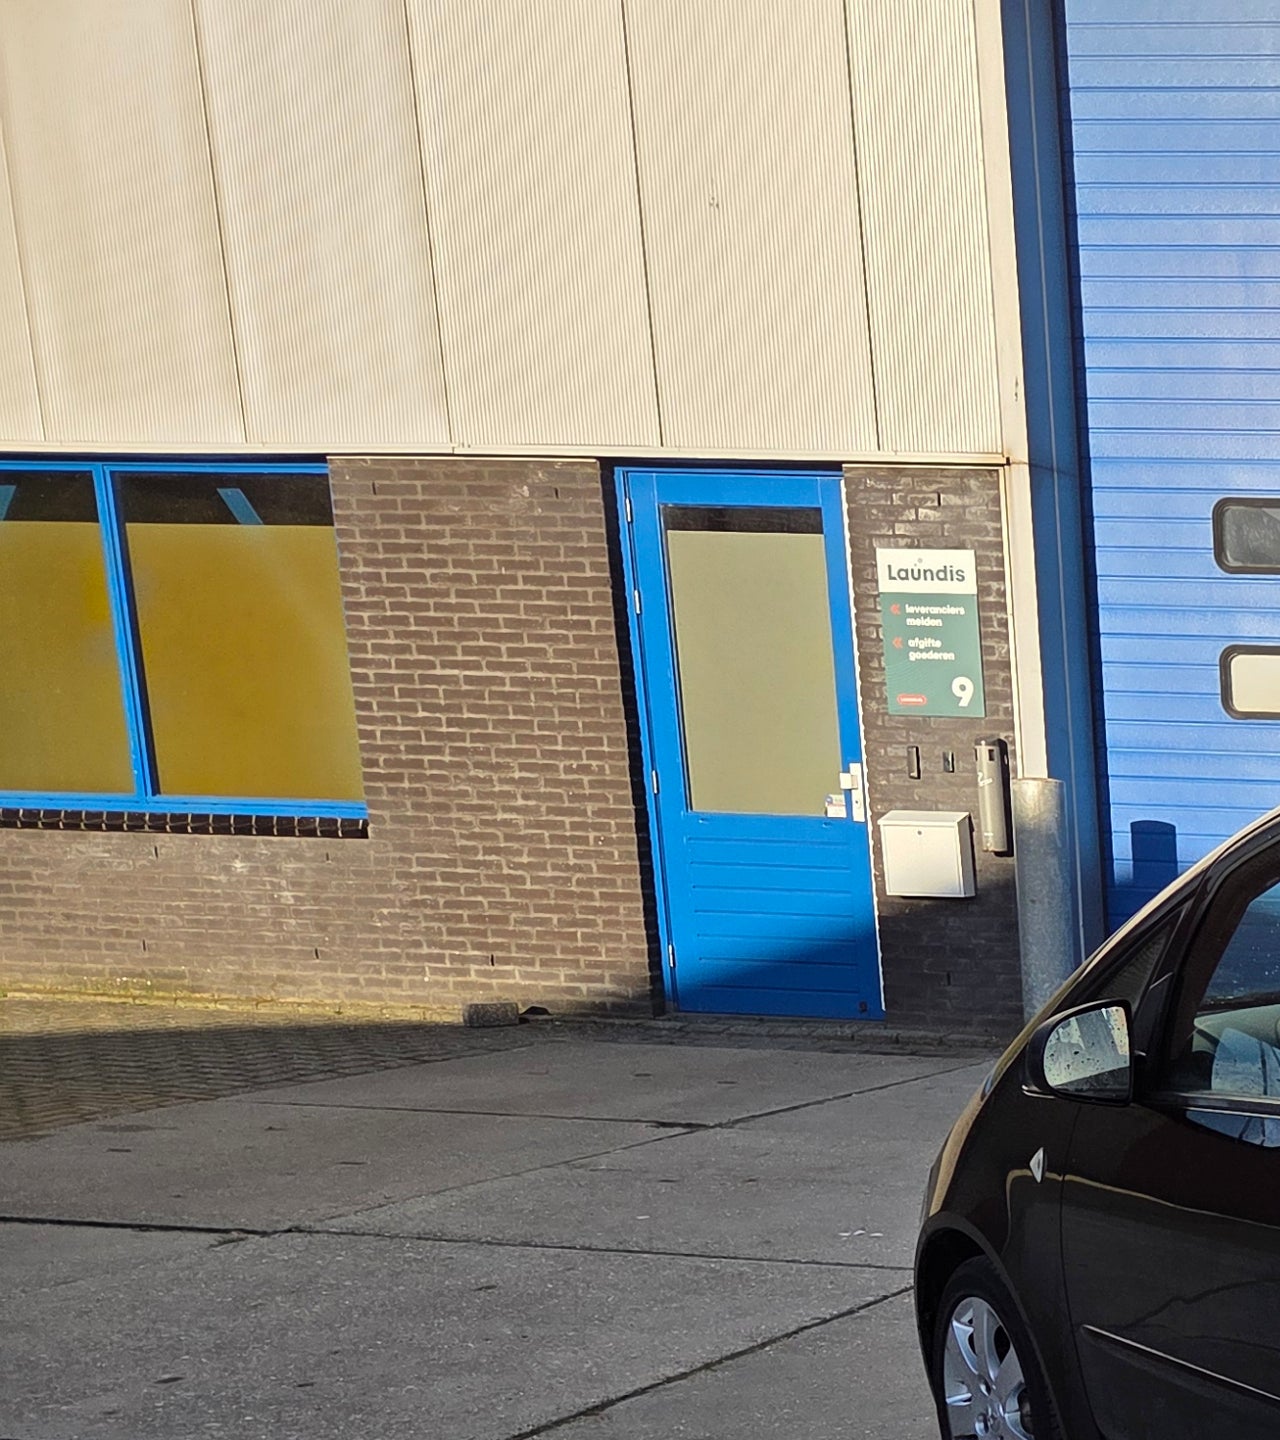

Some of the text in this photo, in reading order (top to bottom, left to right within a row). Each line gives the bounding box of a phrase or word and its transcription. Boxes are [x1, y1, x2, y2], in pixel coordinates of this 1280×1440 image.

[887, 564, 966, 582] Laundis
[905, 603, 966, 615] leveranciers
[908, 637, 942, 649] afgifte
[908, 650, 955, 661] goederen
[951, 676, 974, 707] 9
